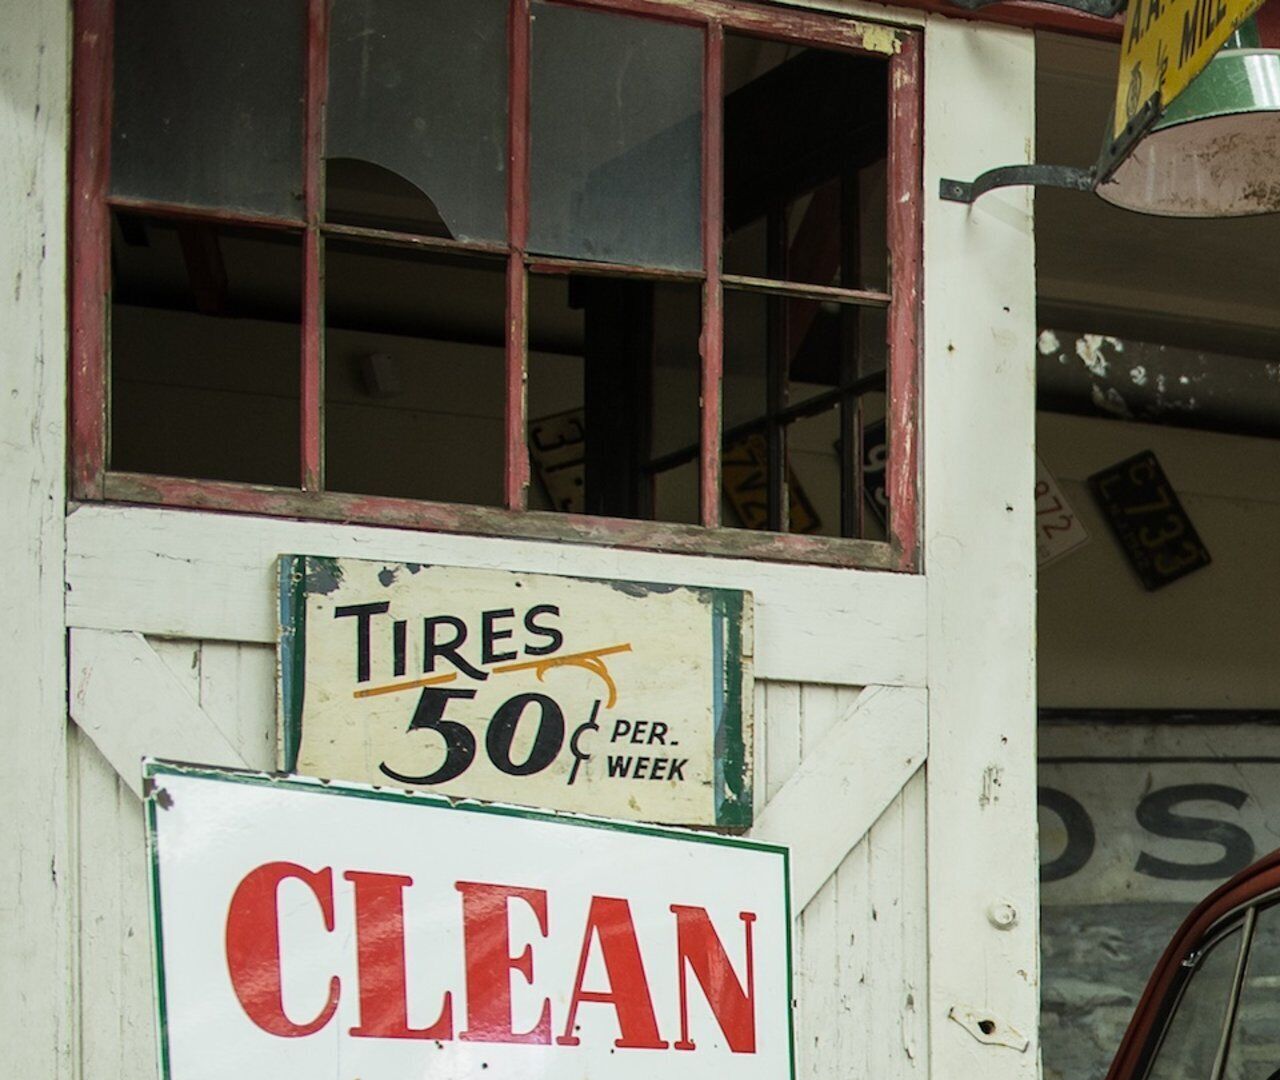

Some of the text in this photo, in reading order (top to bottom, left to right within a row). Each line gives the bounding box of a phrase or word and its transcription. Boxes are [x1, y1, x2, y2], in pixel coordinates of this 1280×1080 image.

[334, 602, 566, 682] TIRES
[606, 754, 689, 783] WEEK
[225, 861, 757, 1055] CLEAN
